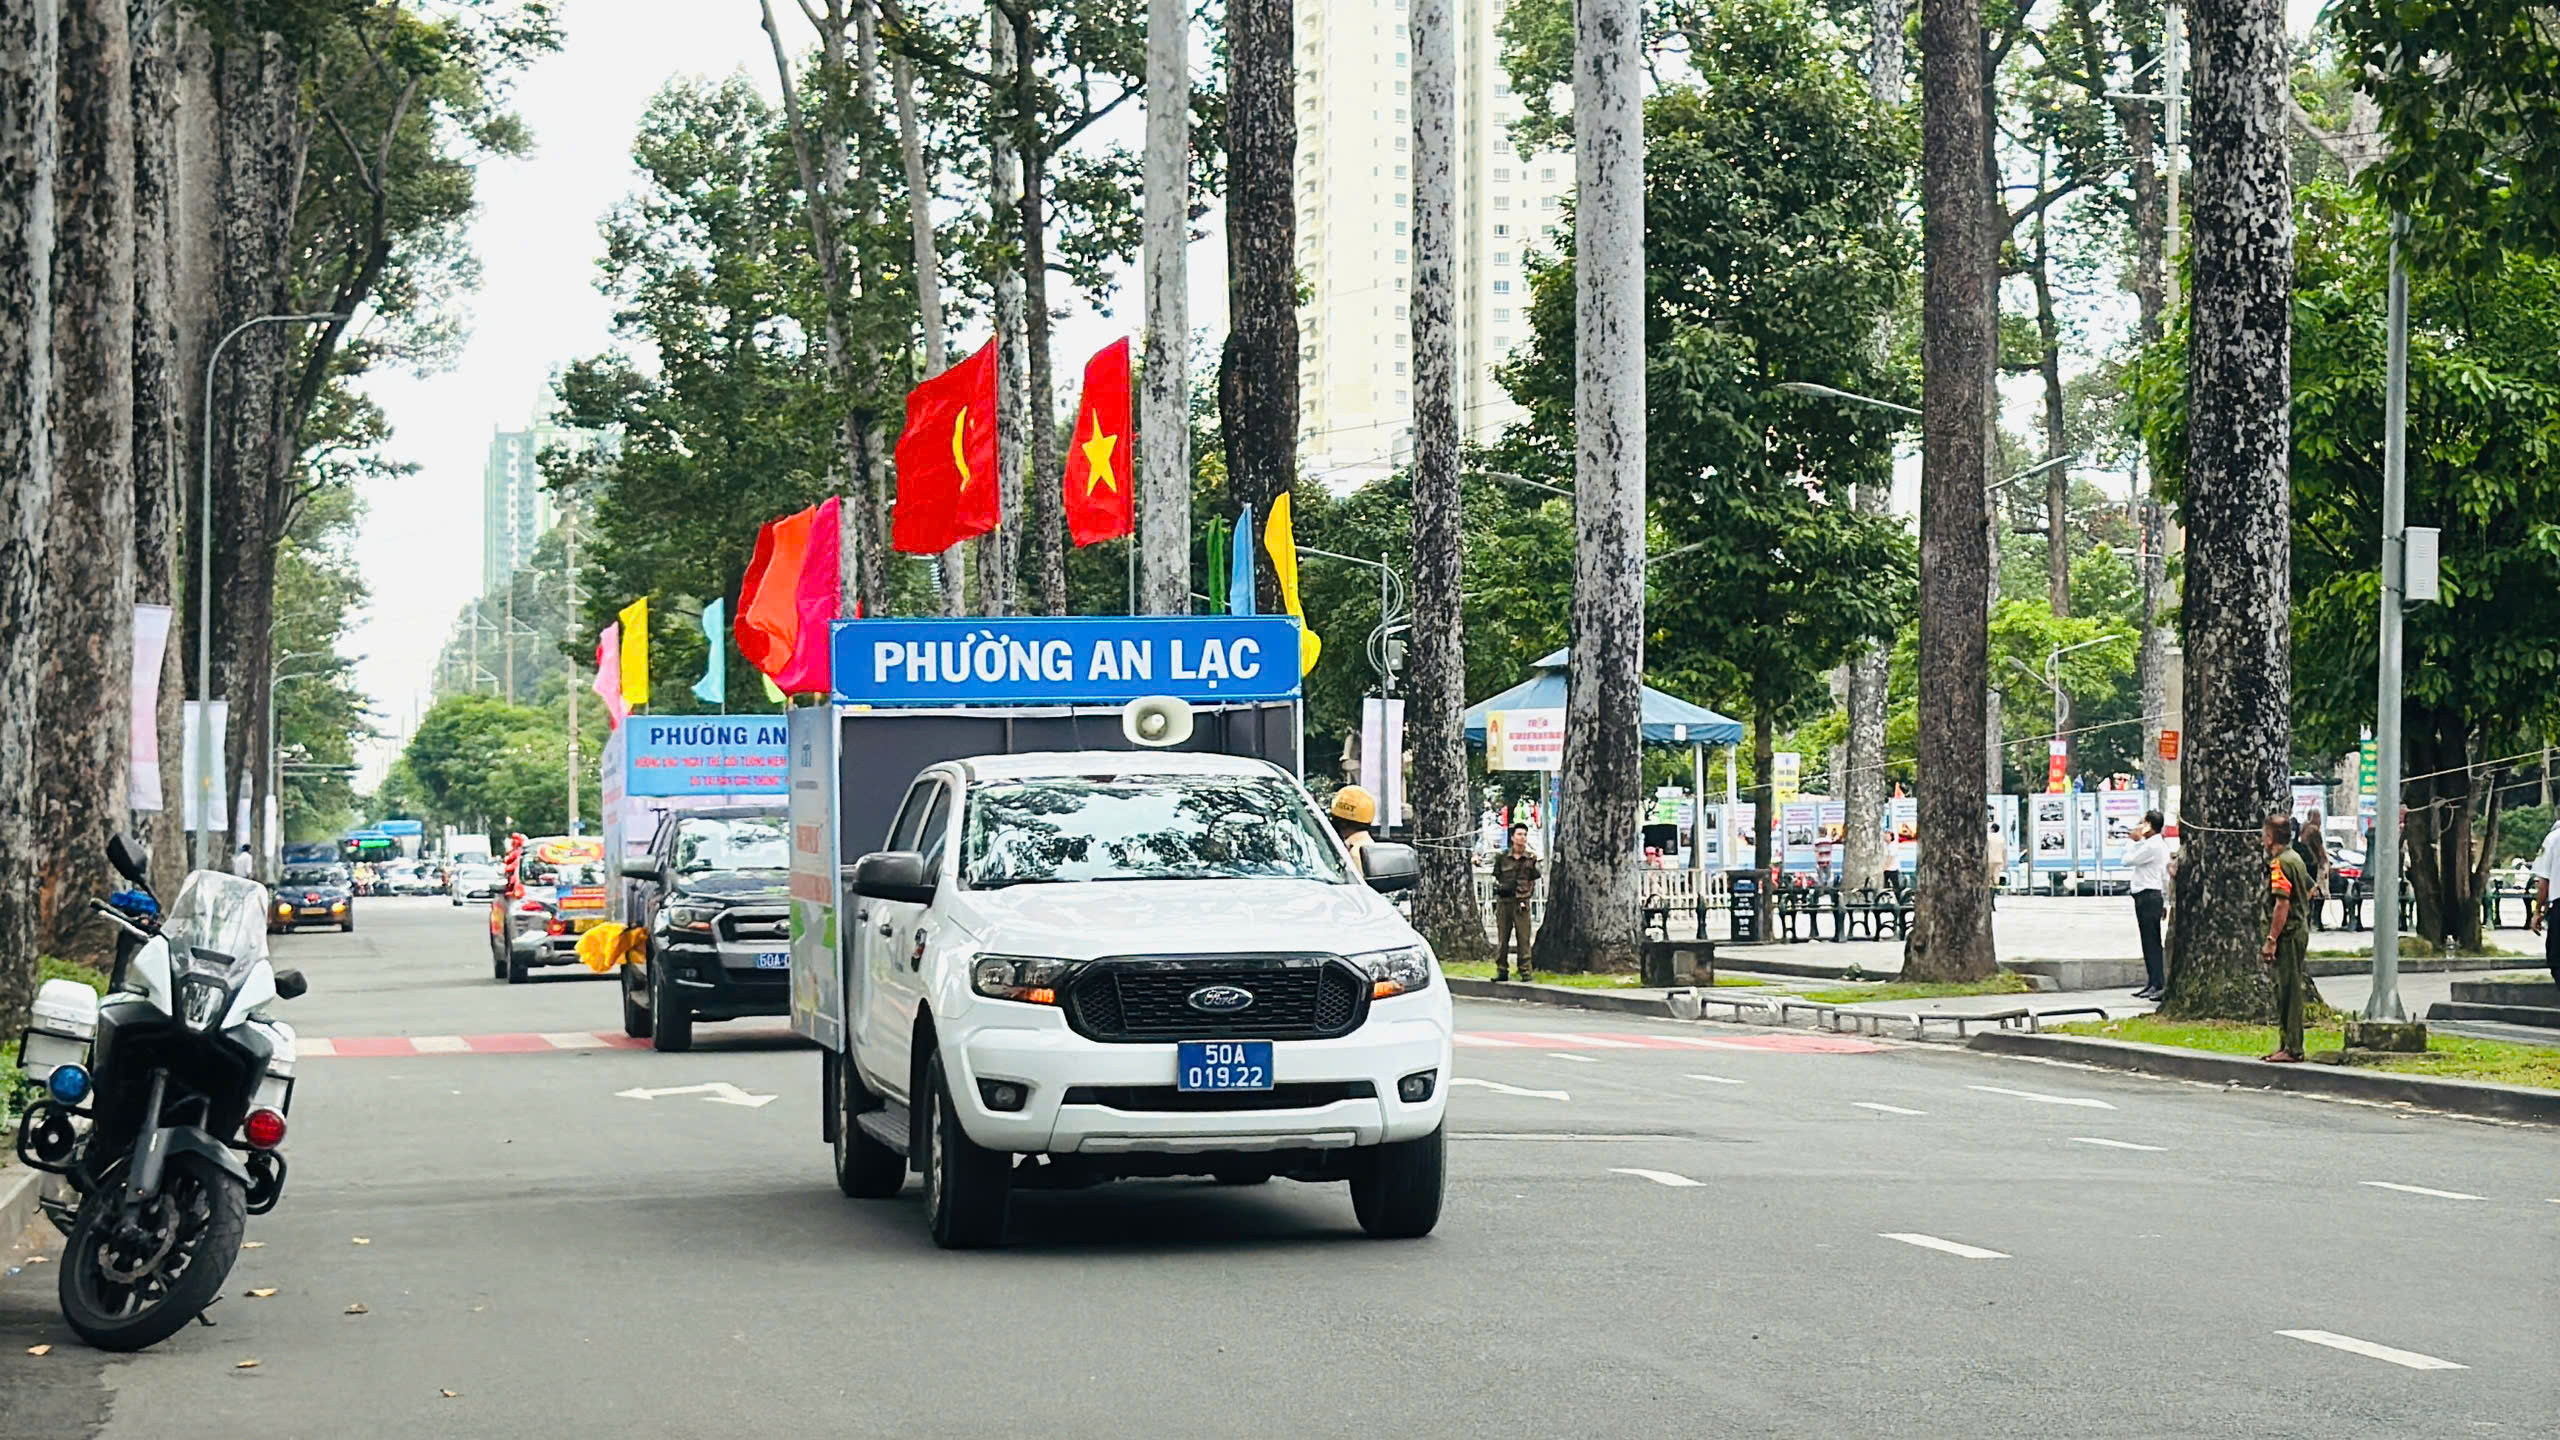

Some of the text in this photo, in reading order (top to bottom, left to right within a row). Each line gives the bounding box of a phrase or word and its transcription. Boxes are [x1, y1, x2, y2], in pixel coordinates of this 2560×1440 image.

[874, 629, 1260, 689] PHƯỜNG AN LẠC
[650, 722, 788, 746] PHƯỜNG AN
[1203, 989, 1239, 1006] Ford
[1205, 1044, 1246, 1065] 50A
[1189, 1066, 1263, 1088] 019.22
